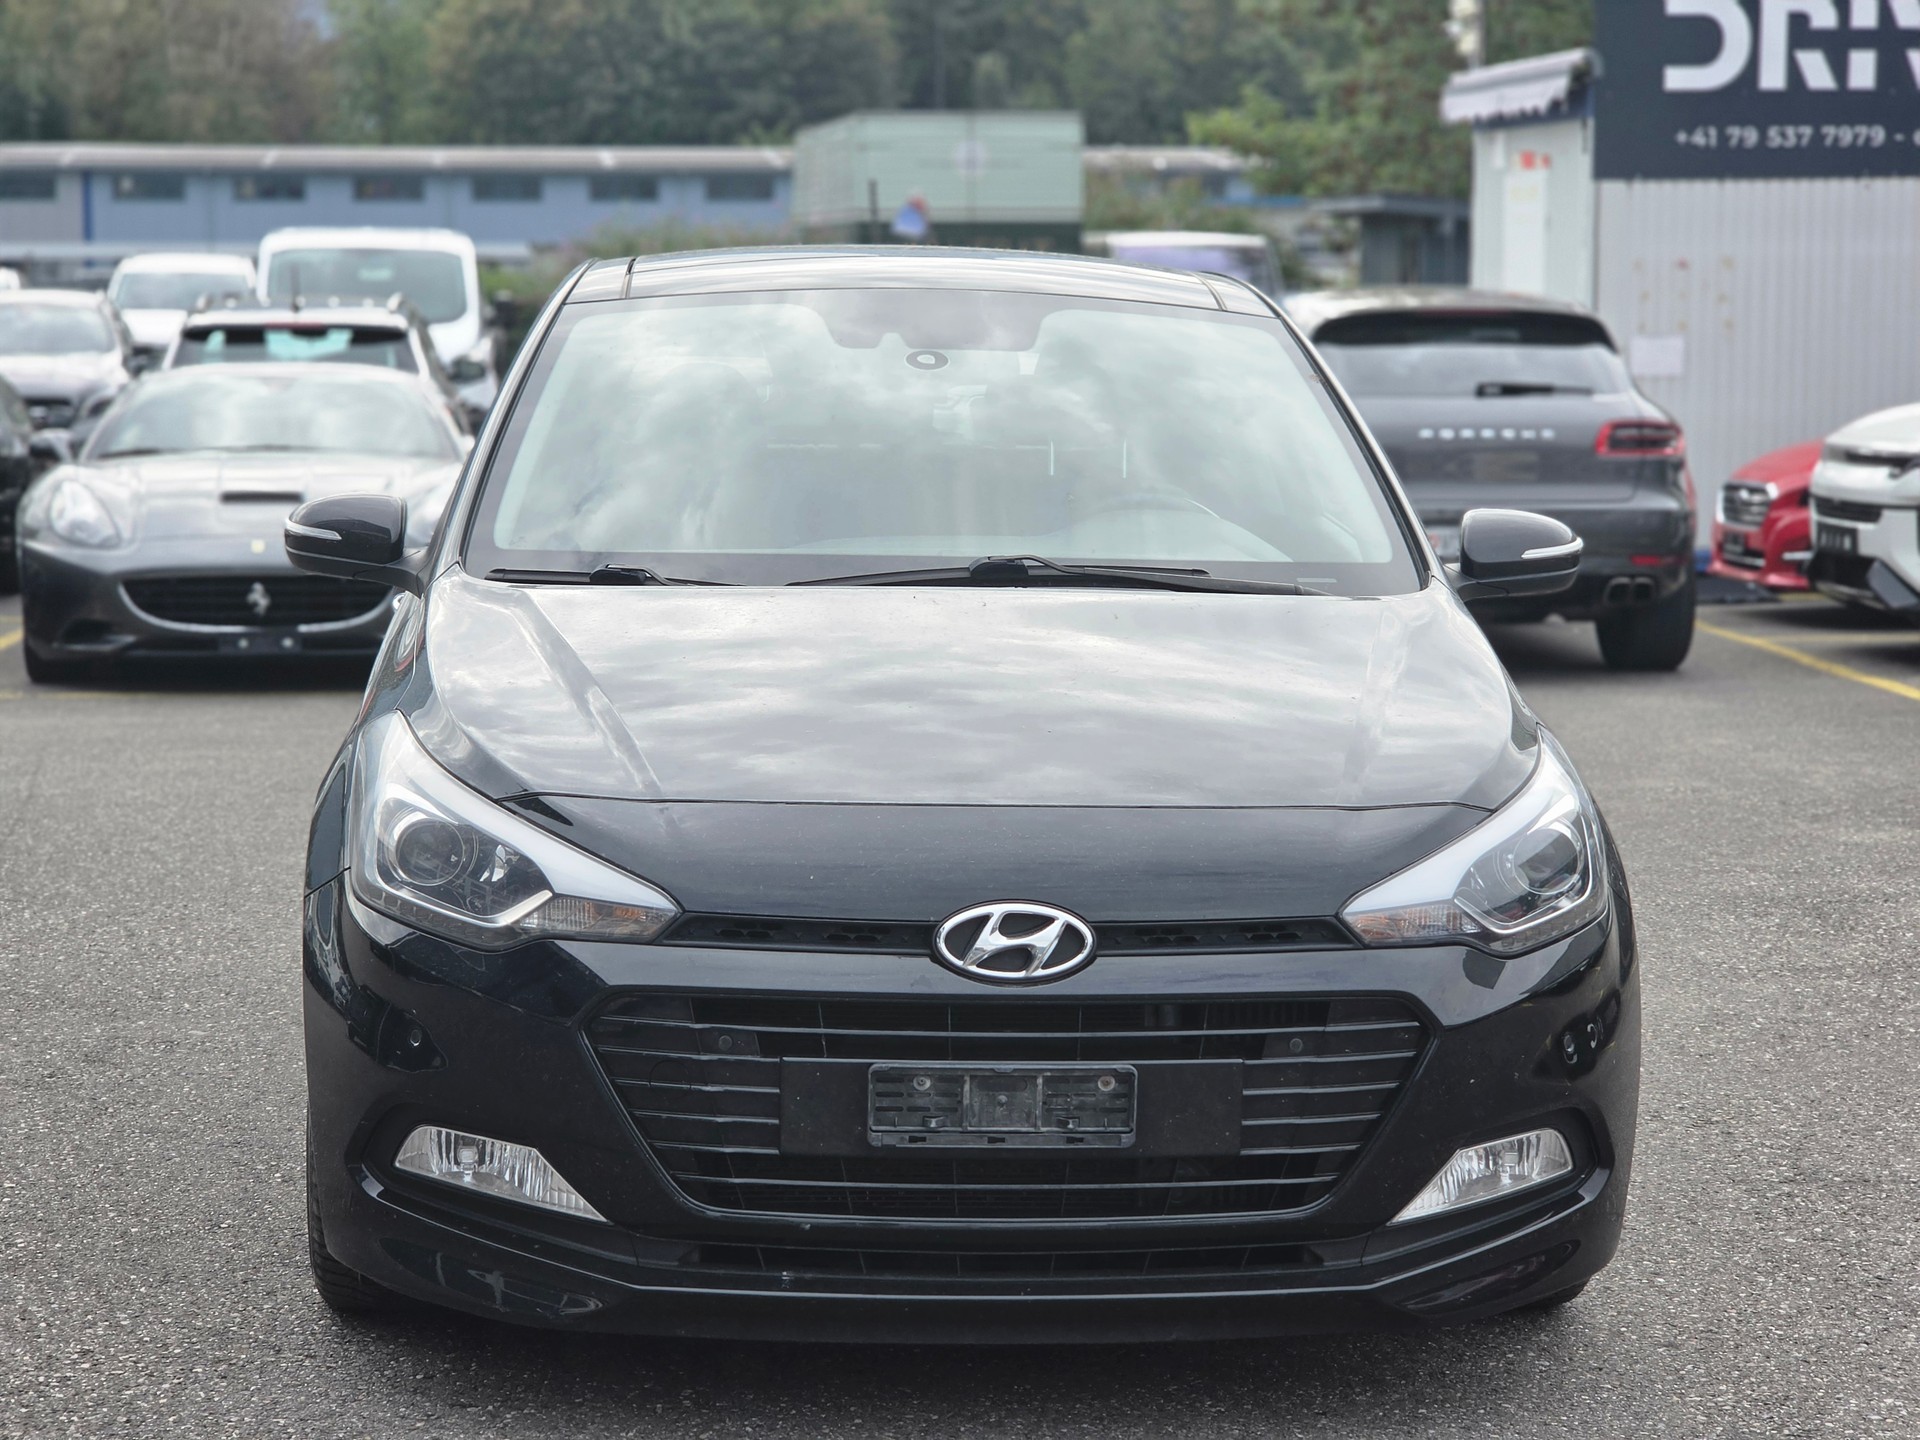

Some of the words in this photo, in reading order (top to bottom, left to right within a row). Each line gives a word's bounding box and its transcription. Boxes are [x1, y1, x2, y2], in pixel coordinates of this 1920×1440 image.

[1675, 126, 1718, 148] +41
[1725, 126, 1758, 148] 79
[1766, 126, 1813, 147] 537
[1821, 125, 1885, 147] 7979
